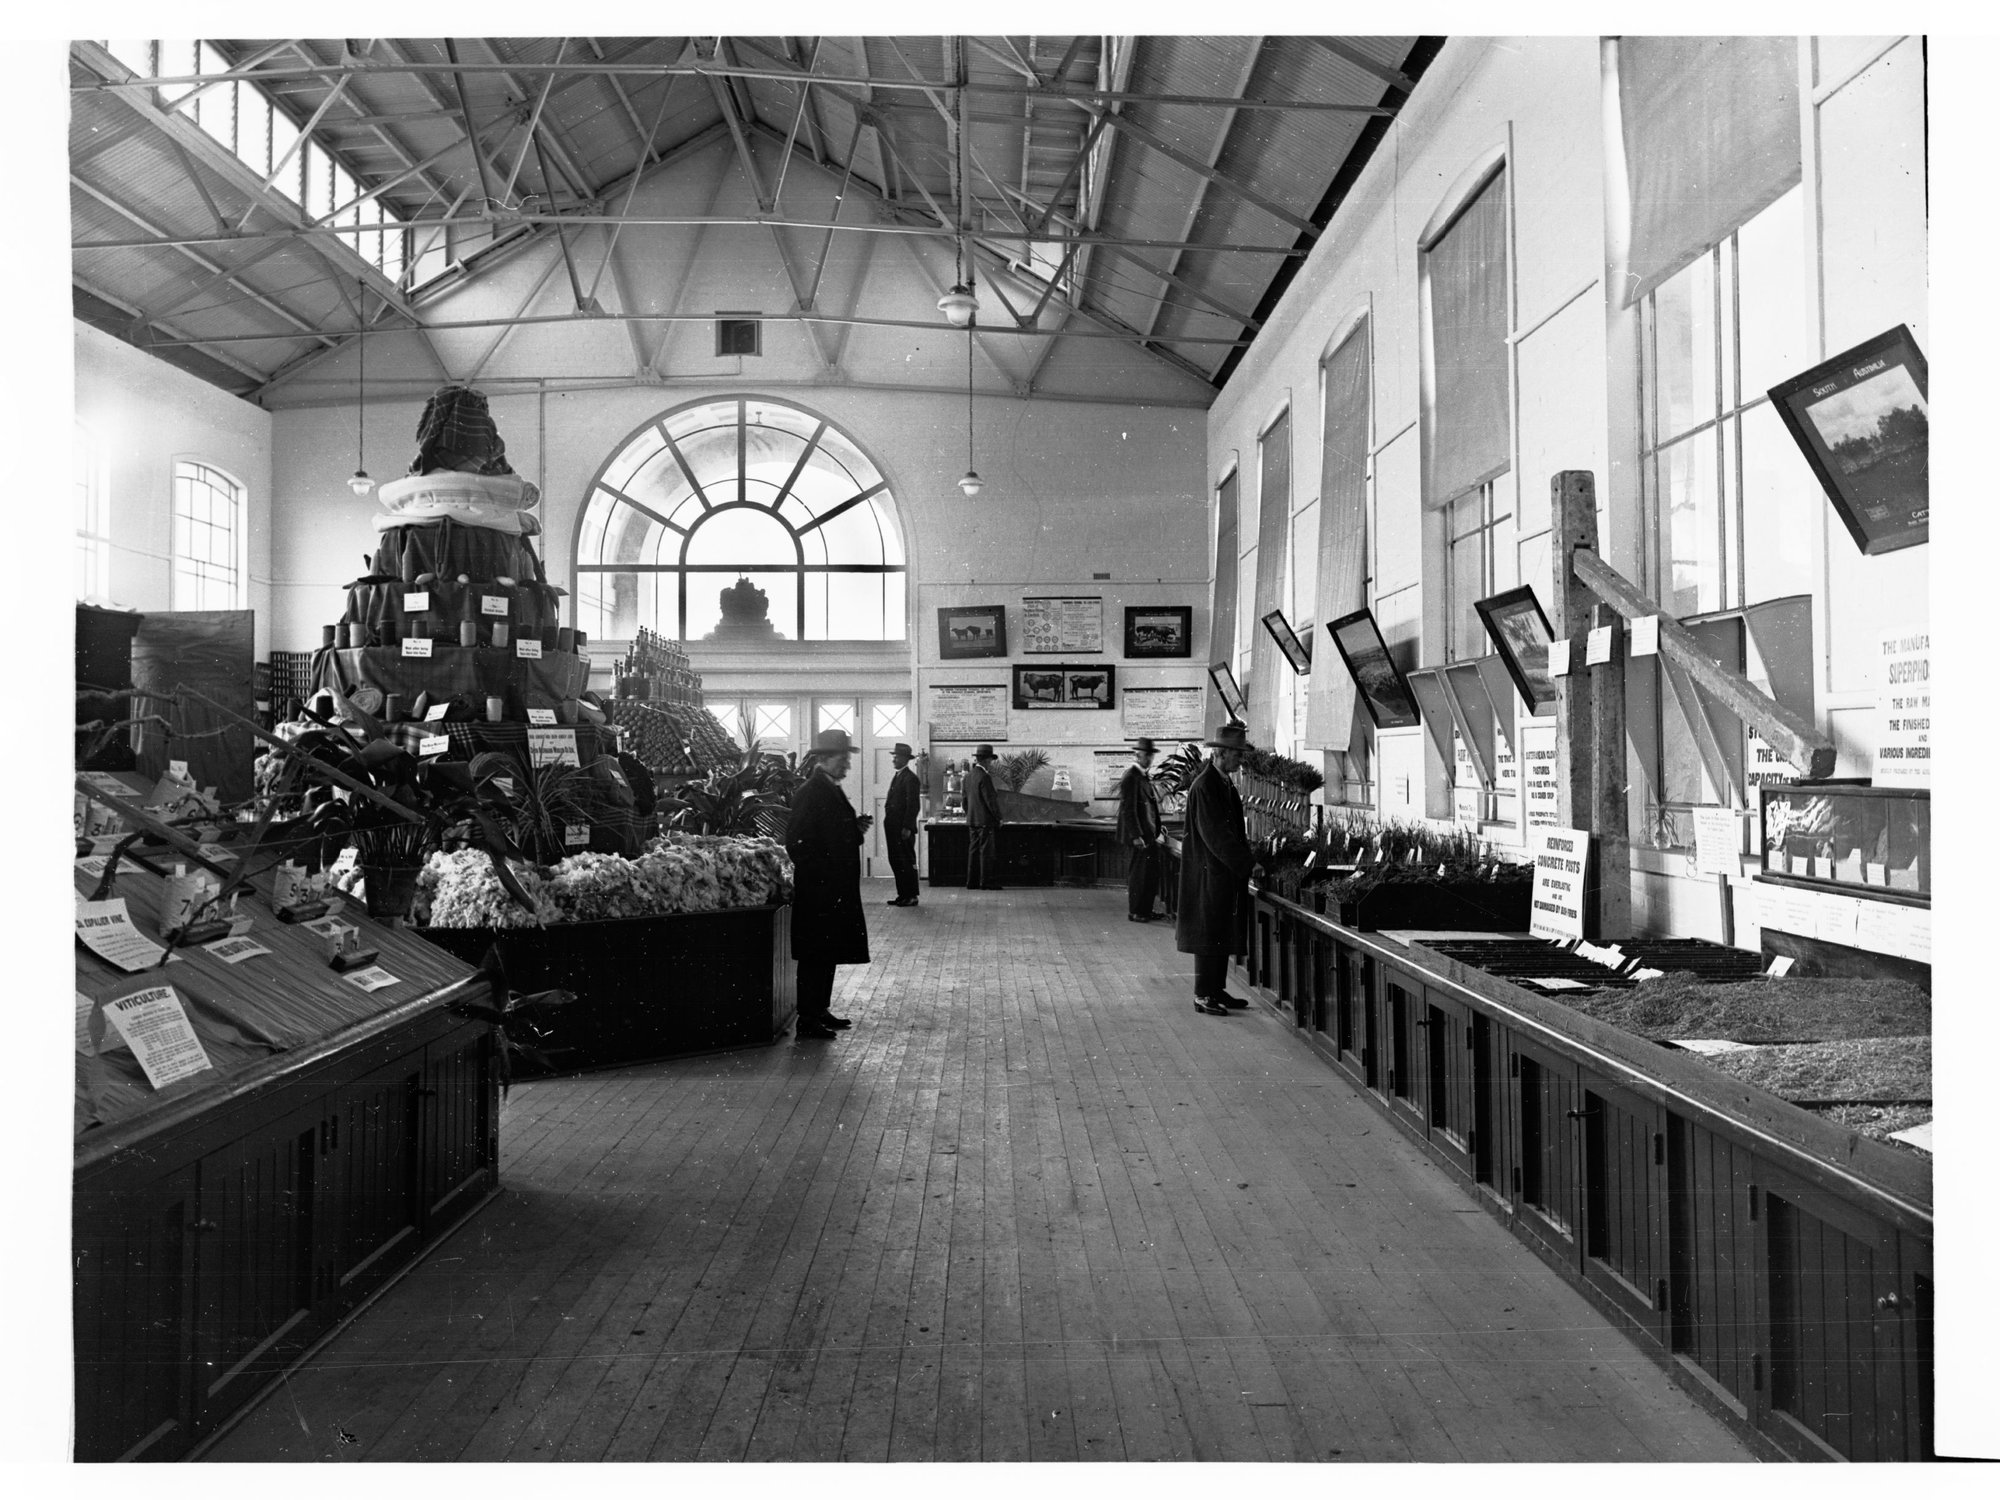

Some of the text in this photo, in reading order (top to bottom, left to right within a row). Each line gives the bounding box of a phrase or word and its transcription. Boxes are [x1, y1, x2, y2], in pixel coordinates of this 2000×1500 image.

[1883, 641, 1896, 655] THE
[1892, 698, 1903, 709] THE
[1889, 718, 1930, 731] THE FINISHED
[1757, 749, 1773, 763] THE
[1880, 747, 1903, 759] VARIOUS
[1547, 837, 1574, 853] REINFORCED
[1538, 854, 1581, 875] CONCRETE POSTS
[181, 899, 191, 915] 7
